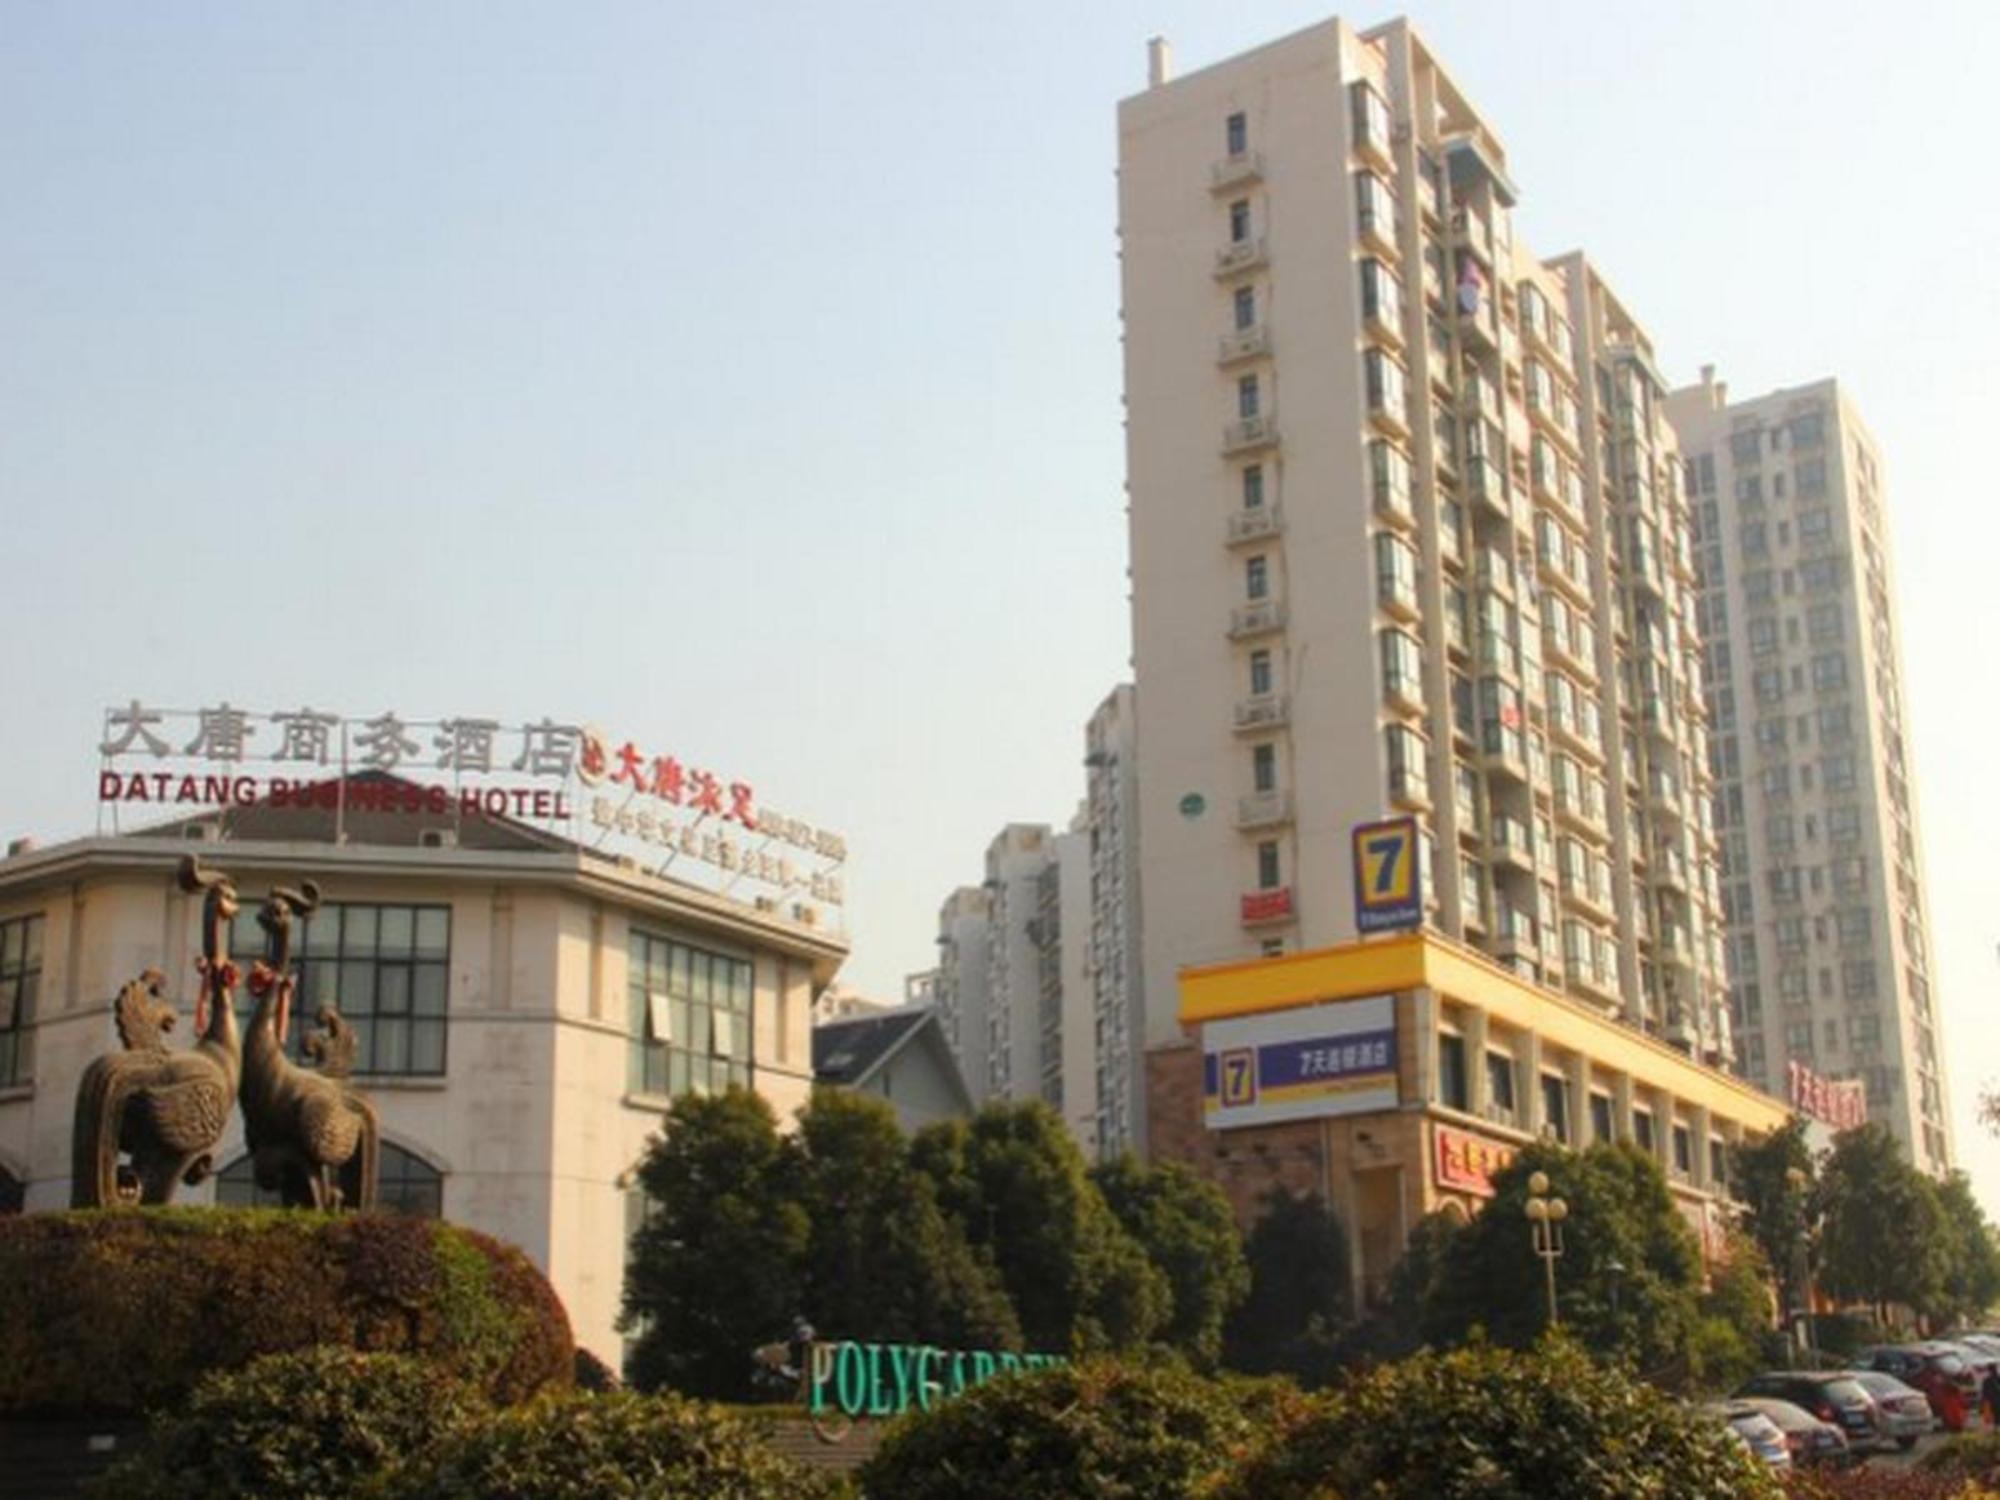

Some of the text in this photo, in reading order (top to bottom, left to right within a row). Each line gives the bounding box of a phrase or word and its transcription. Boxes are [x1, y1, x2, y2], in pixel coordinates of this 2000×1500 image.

[98, 700, 576, 777] 大唐商务酒店
[99, 770, 572, 820] DATANG BUSINESS HOTEL
[1367, 836, 1402, 893] 7
[1228, 1059, 1246, 1096] 7
